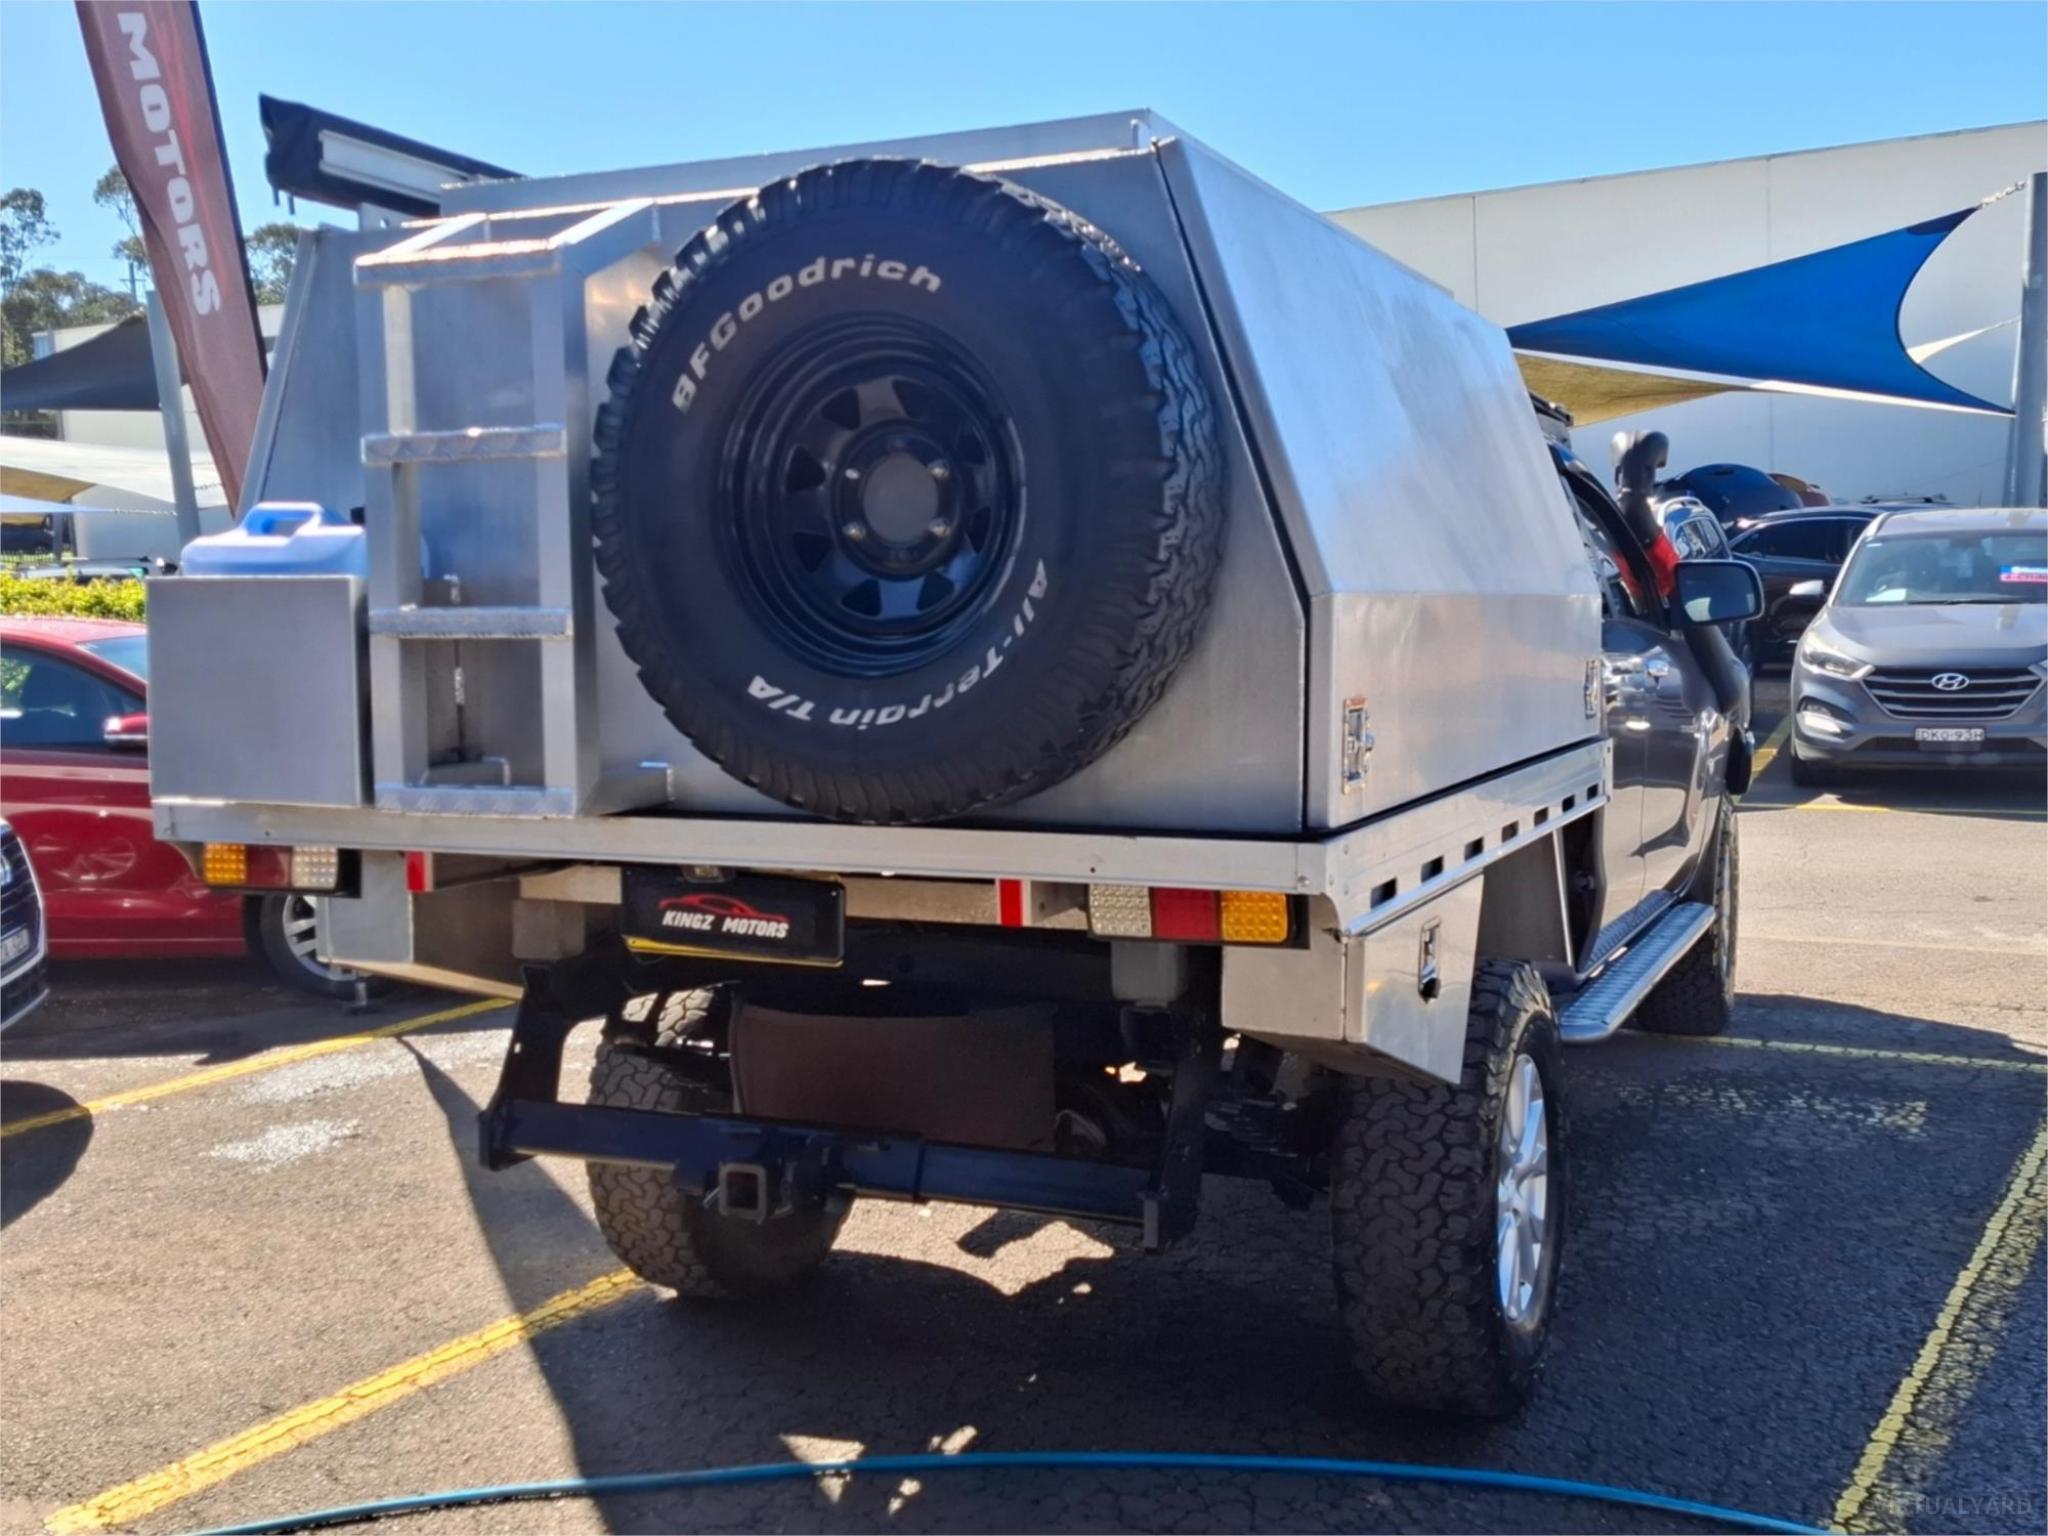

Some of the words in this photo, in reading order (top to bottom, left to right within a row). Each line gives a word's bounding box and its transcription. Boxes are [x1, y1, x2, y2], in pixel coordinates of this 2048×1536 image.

[117, 12, 221, 316] MOTORS
[672, 253, 941, 412] BFGoodrich
[746, 674, 814, 722] T/A
[828, 559, 1049, 731] All-Terrain
[663, 910, 715, 930] KINGZ
[721, 917, 789, 938] MOTORS
